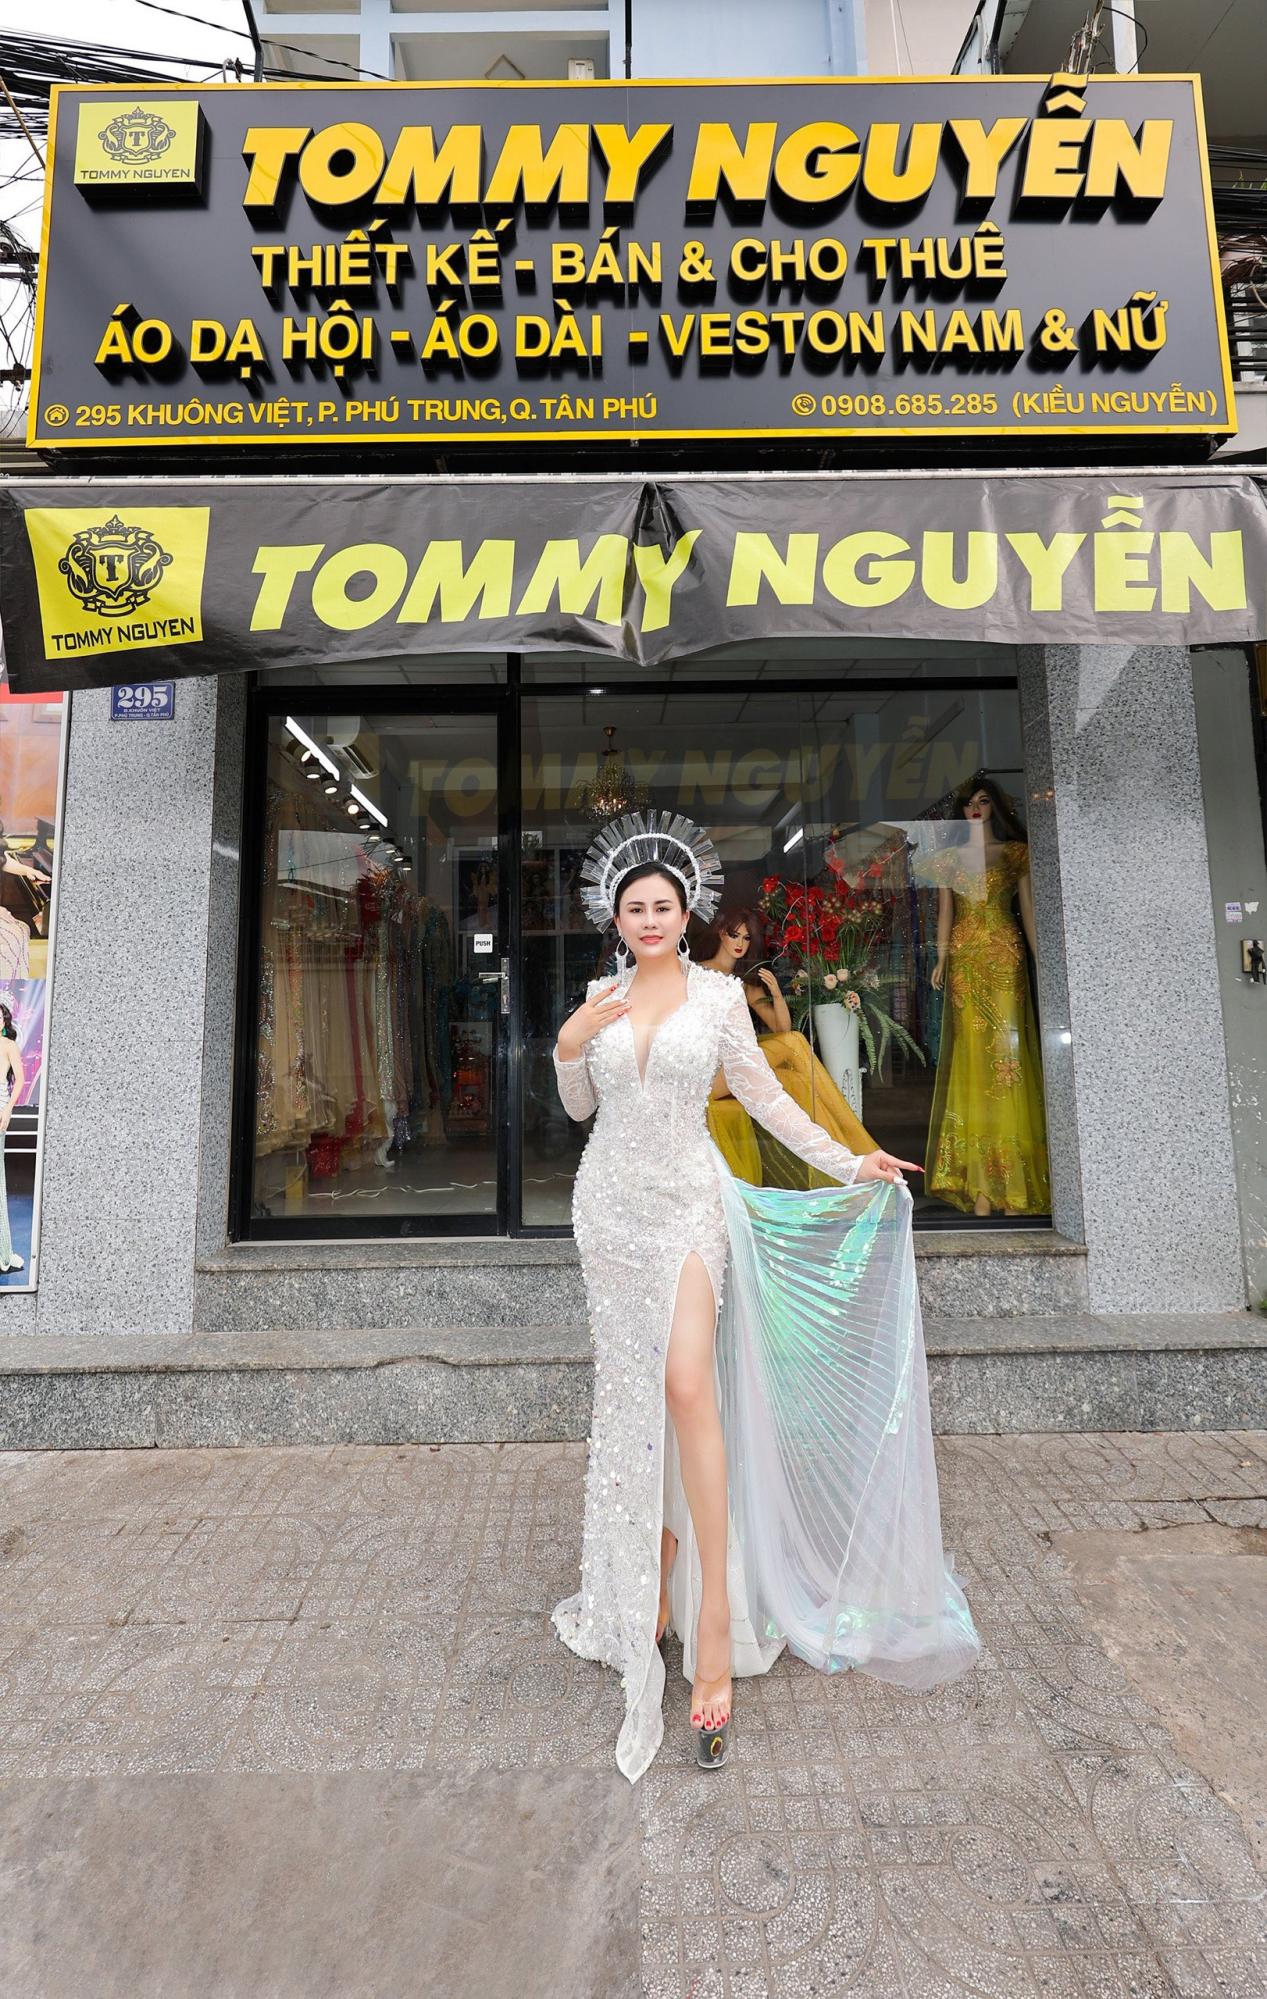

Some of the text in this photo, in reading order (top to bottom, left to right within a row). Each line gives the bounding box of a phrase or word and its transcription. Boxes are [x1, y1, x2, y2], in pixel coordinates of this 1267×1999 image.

[242, 72, 1175, 207] TOMMY NGUYỄN
[80, 168, 191, 180] TOMMY NGUYEN
[251, 219, 1008, 288] THIẾT KẾ - BÁN & CHO THUÊ
[95, 303, 172, 364] ÁO
[190, 318, 265, 379] DẠ
[282, 299, 373, 378] HỘI
[421, 299, 498, 359] ÁO
[515, 298, 602, 357] DÀI
[659, 309, 886, 356] VESTON
[901, 308, 1025, 354] NAM
[1040, 308, 1079, 352] &
[1094, 289, 1169, 352] NỮ
[75, 404, 122, 427] 295
[127, 397, 244, 426] KHUÔNG
[248, 396, 313, 429] VIỆT,
[318, 401, 338, 423] P.
[345, 396, 400, 422] PHÚ
[540, 393, 600, 420] TÂN
[603, 392, 657, 418] PHÚ
[821, 382, 1218, 419] 0908.685.285 (KIỀU NGUYỄN)
[250, 496, 1248, 633] TOMMY NGUYỄN
[51, 616, 196, 652] TOMMY NGUYEN
[117, 686, 169, 708] 295
